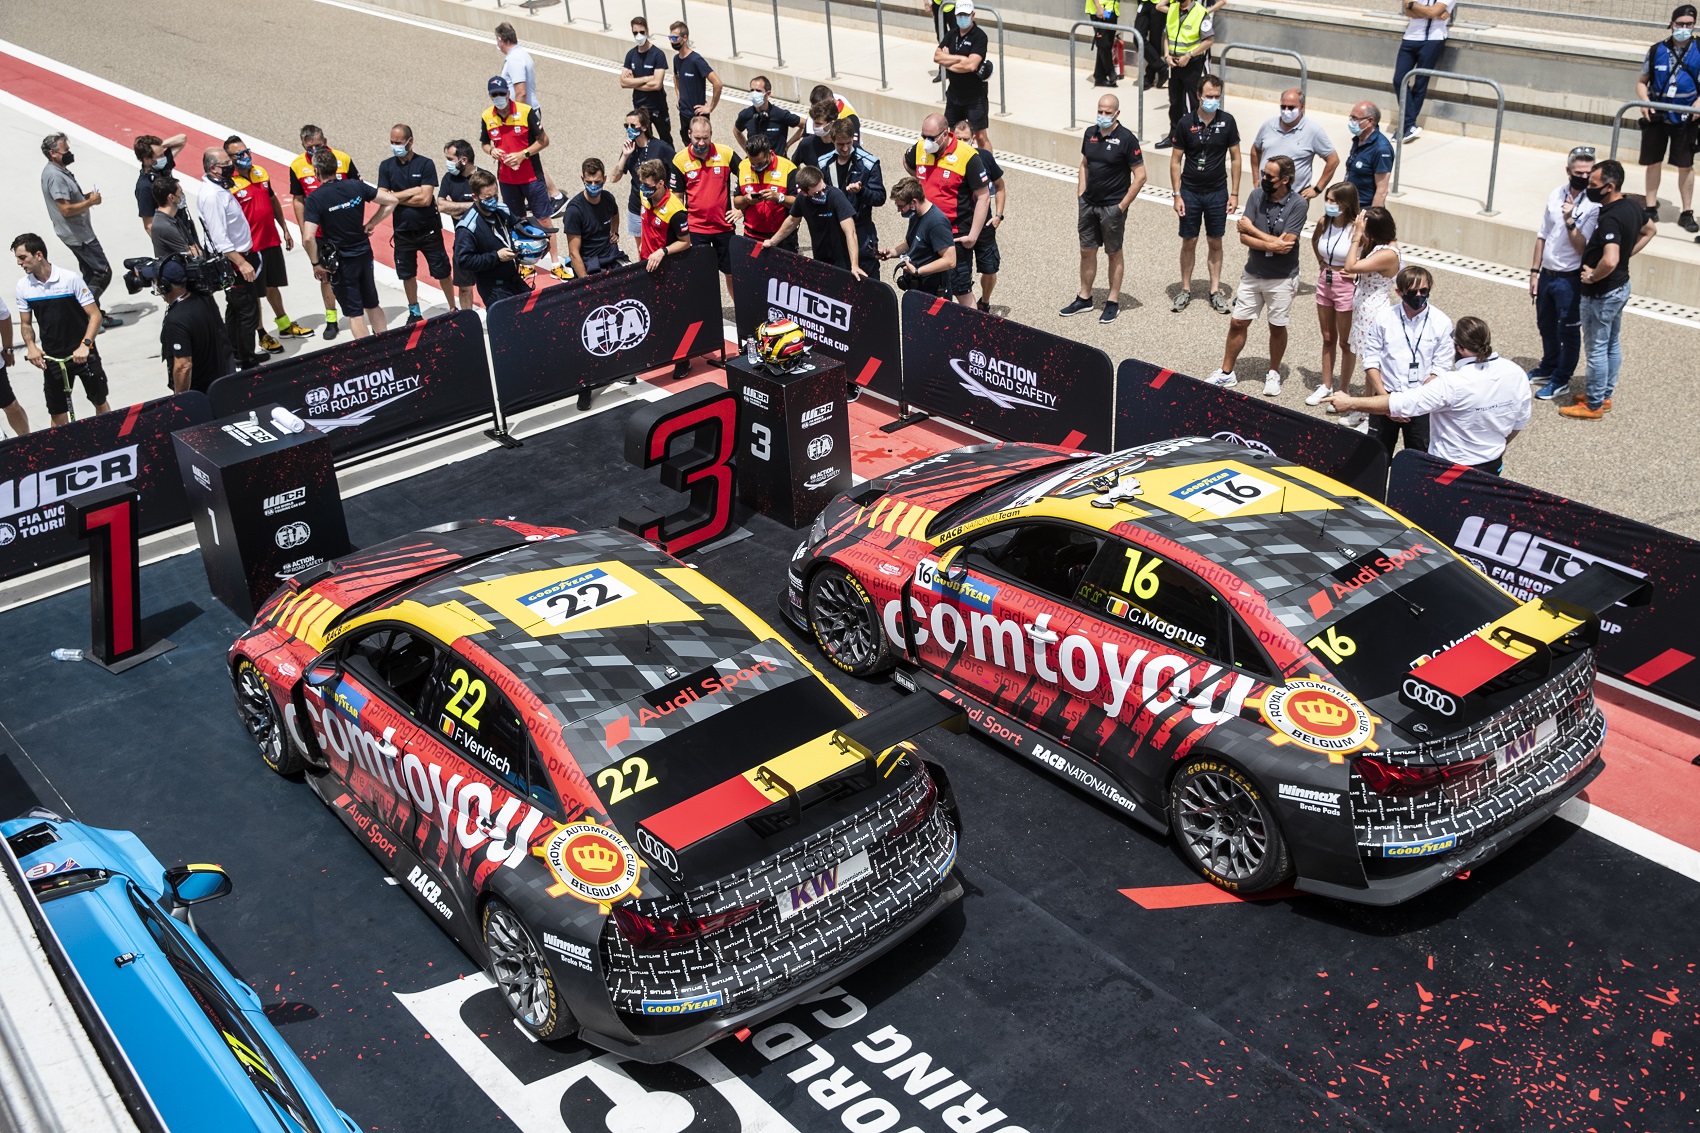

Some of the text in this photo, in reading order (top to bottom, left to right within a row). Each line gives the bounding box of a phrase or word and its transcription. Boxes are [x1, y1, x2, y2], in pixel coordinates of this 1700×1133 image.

[767, 277, 852, 331] WTCR
[800, 318, 824, 334] WORLD
[818, 335, 833, 347] CAR
[834, 342, 849, 353] CUP
[332, 367, 395, 398] ACTION
[969, 365, 1056, 406] FOR ROAD SAFETY
[988, 358, 1037, 387] ACTION
[309, 375, 419, 416] FOR ROAD SAFETY
[801, 401, 834, 423] WTCR
[751, 422, 771, 461] 3
[644, 397, 737, 556] 3
[1180, 471, 1238, 497] GOODYEAR
[1202, 479, 1264, 505] 16
[263, 486, 305, 510] WTCR
[18, 513, 41, 528] FIA
[20, 517, 66, 538] TOURI
[207, 507, 220, 545] 1
[292, 555, 314, 567] ACTION
[791, 541, 808, 561] 16
[1454, 516, 1640, 588] WTC
[86, 501, 131, 656] 1
[527, 573, 594, 602] GOODYEAR
[845, 573, 870, 604] EAGLE
[919, 562, 933, 584] 16
[933, 574, 990, 605] GOODYEAR
[1121, 547, 1164, 600] 16
[1332, 565, 1380, 601] Audi
[1377, 542, 1432, 573] Sport
[1491, 567, 1553, 594] FIA WOR
[546, 583, 623, 620] 22
[1023, 598, 1085, 628] printing
[1090, 622, 1160, 655] dynamic
[1128, 608, 1207, 648] G.Magnus
[1307, 626, 1357, 665] 16
[1600, 620, 1622, 634] UP
[883, 597, 1257, 726] comtoyou
[445, 669, 487, 731] 22
[489, 668, 544, 711] printing
[638, 657, 778, 727] Audi Sport
[1268, 681, 1369, 732] ROYAL AUTOMOBILE CLUB
[954, 697, 1023, 746] Audi Sport
[1291, 729, 1355, 749] BELGIUM
[415, 732, 465, 773] dynamic
[455, 726, 511, 775] F.Vervisch
[1504, 729, 1537, 767] KW
[285, 702, 544, 869] comtoyou
[596, 757, 659, 806] 22
[1300, 802, 1341, 817] Brake Pads
[347, 803, 397, 858] Audi Sport
[1387, 840, 1454, 856] GOODYEAR
[549, 825, 636, 877] ROYAL AUTOMOBILE CLUB
[407, 865, 453, 920] RACB.com
[570, 878, 622, 897] BELGIUM
[790, 866, 839, 912] KW
[561, 954, 593, 972] Brake Pads
[647, 998, 718, 1014] GOODYEAR
[752, 1022, 901, 1133] ORLD
